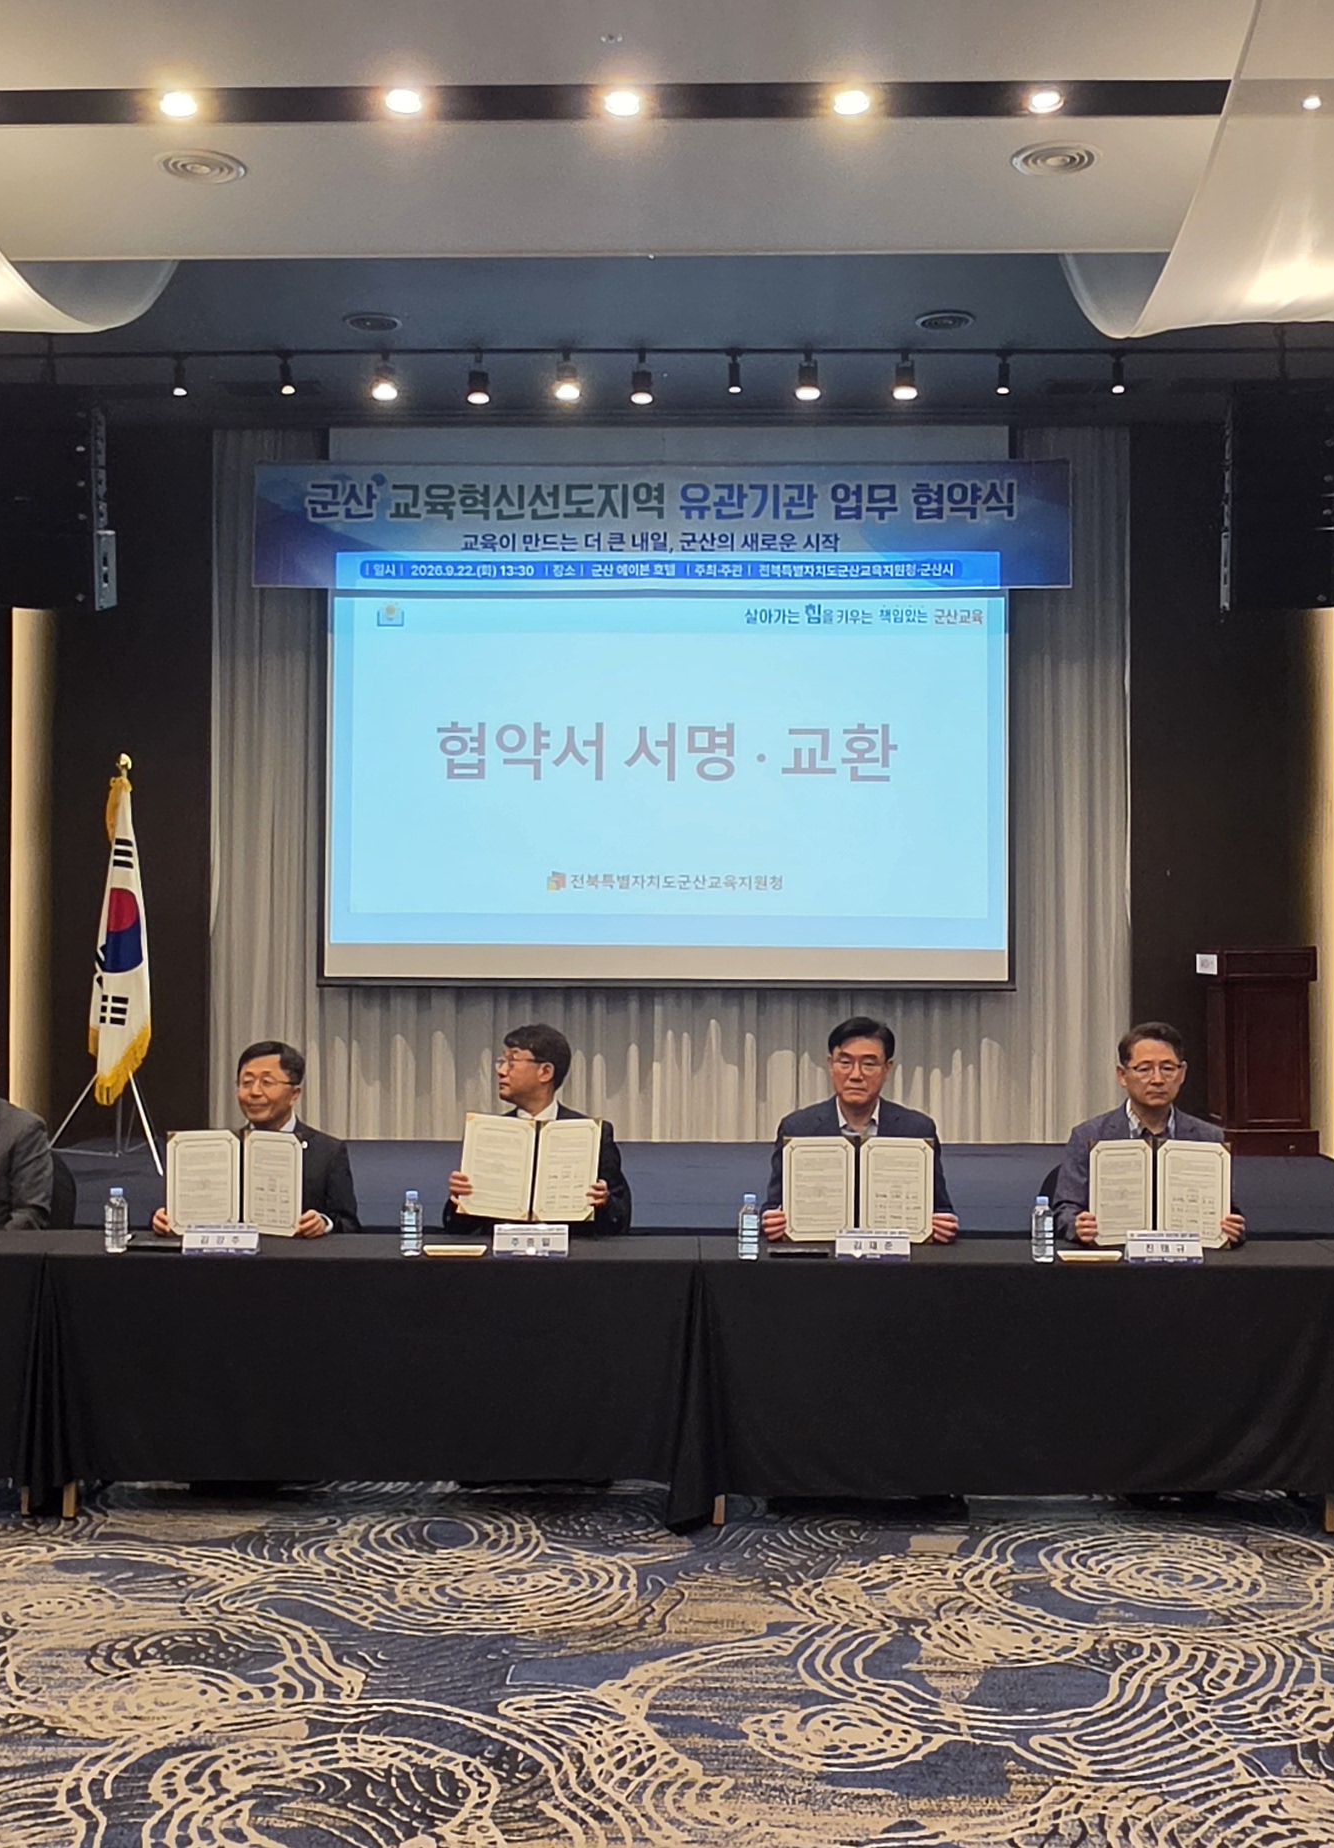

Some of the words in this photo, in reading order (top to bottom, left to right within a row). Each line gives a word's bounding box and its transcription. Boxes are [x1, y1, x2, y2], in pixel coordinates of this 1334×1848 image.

[306, 482, 377, 520] 군산
[389, 482, 666, 521] 교육혁신선도지역
[679, 482, 818, 521] 유관기관
[830, 482, 899, 521] 업무
[911, 481, 1016, 521] 협약식
[461, 533, 517, 552] 교육이
[522, 533, 579, 552] 만드는
[584, 532, 602, 552] 더
[607, 532, 626, 552] 큰
[631, 531, 674, 554] 내일,
[679, 532, 735, 553] 군산의
[741, 532, 798, 553] 새로운
[802, 532, 841, 553] 시작
[373, 564, 396, 576] 일시
[500, 565, 535, 577] 13:30
[553, 564, 576, 577] 장소
[591, 564, 614, 577] 군산
[652, 564, 676, 577] 호텔
[744, 608, 800, 625] 살아가는
[804, 604, 834, 625] 힘을
[836, 609, 873, 625] 키우는
[879, 608, 928, 623] 책임있는
[934, 608, 984, 625] 군산교육
[436, 721, 605, 781] 협약서
[623, 722, 736, 782] 서명
[781, 723, 899, 782] 교환
[570, 873, 784, 891] 전북특별자치도군산교육지원청
